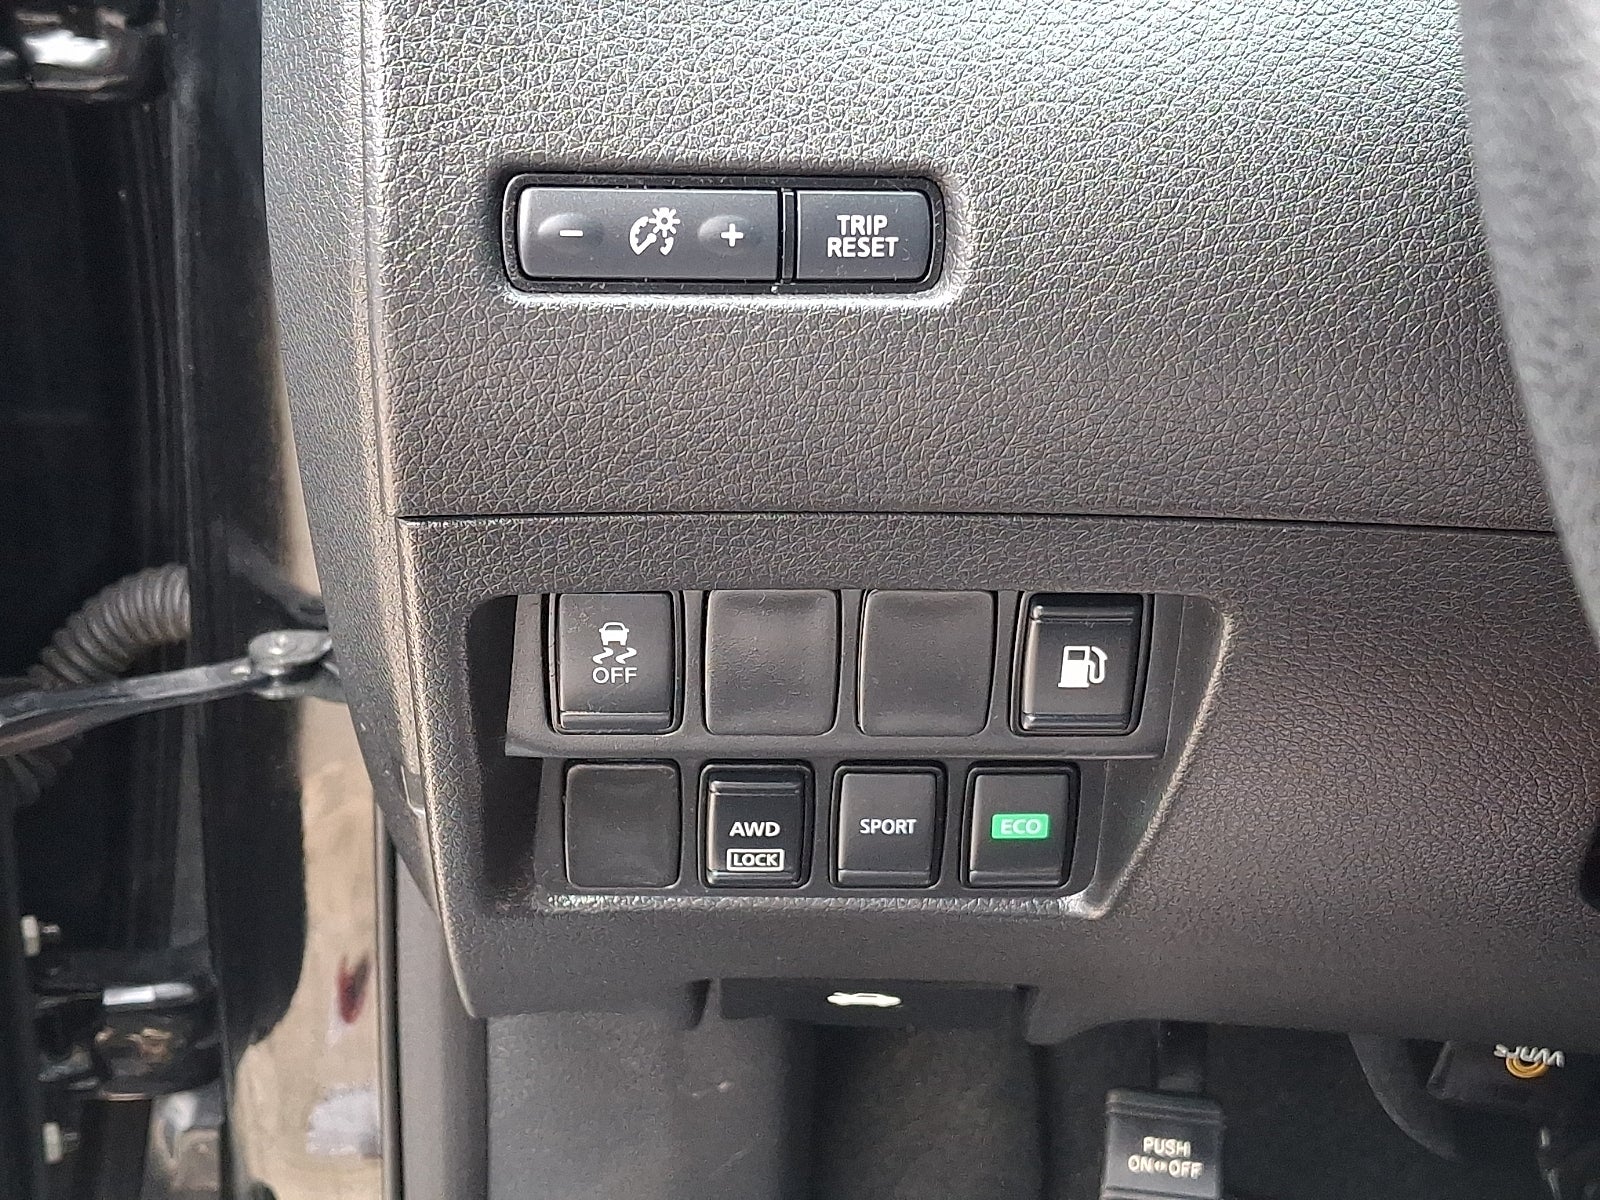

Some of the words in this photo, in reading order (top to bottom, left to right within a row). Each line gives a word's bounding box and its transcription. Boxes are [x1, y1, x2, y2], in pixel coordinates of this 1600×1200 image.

[836, 214, 888, 236] TRIP
[827, 236, 899, 258] RESET
[592, 666, 638, 684] OFF
[729, 821, 781, 838] AWD
[859, 818, 917, 835] SPORT
[1000, 819, 1041, 834] ECO
[732, 853, 779, 867] LOCK
[1143, 1136, 1191, 1158] PUSH
